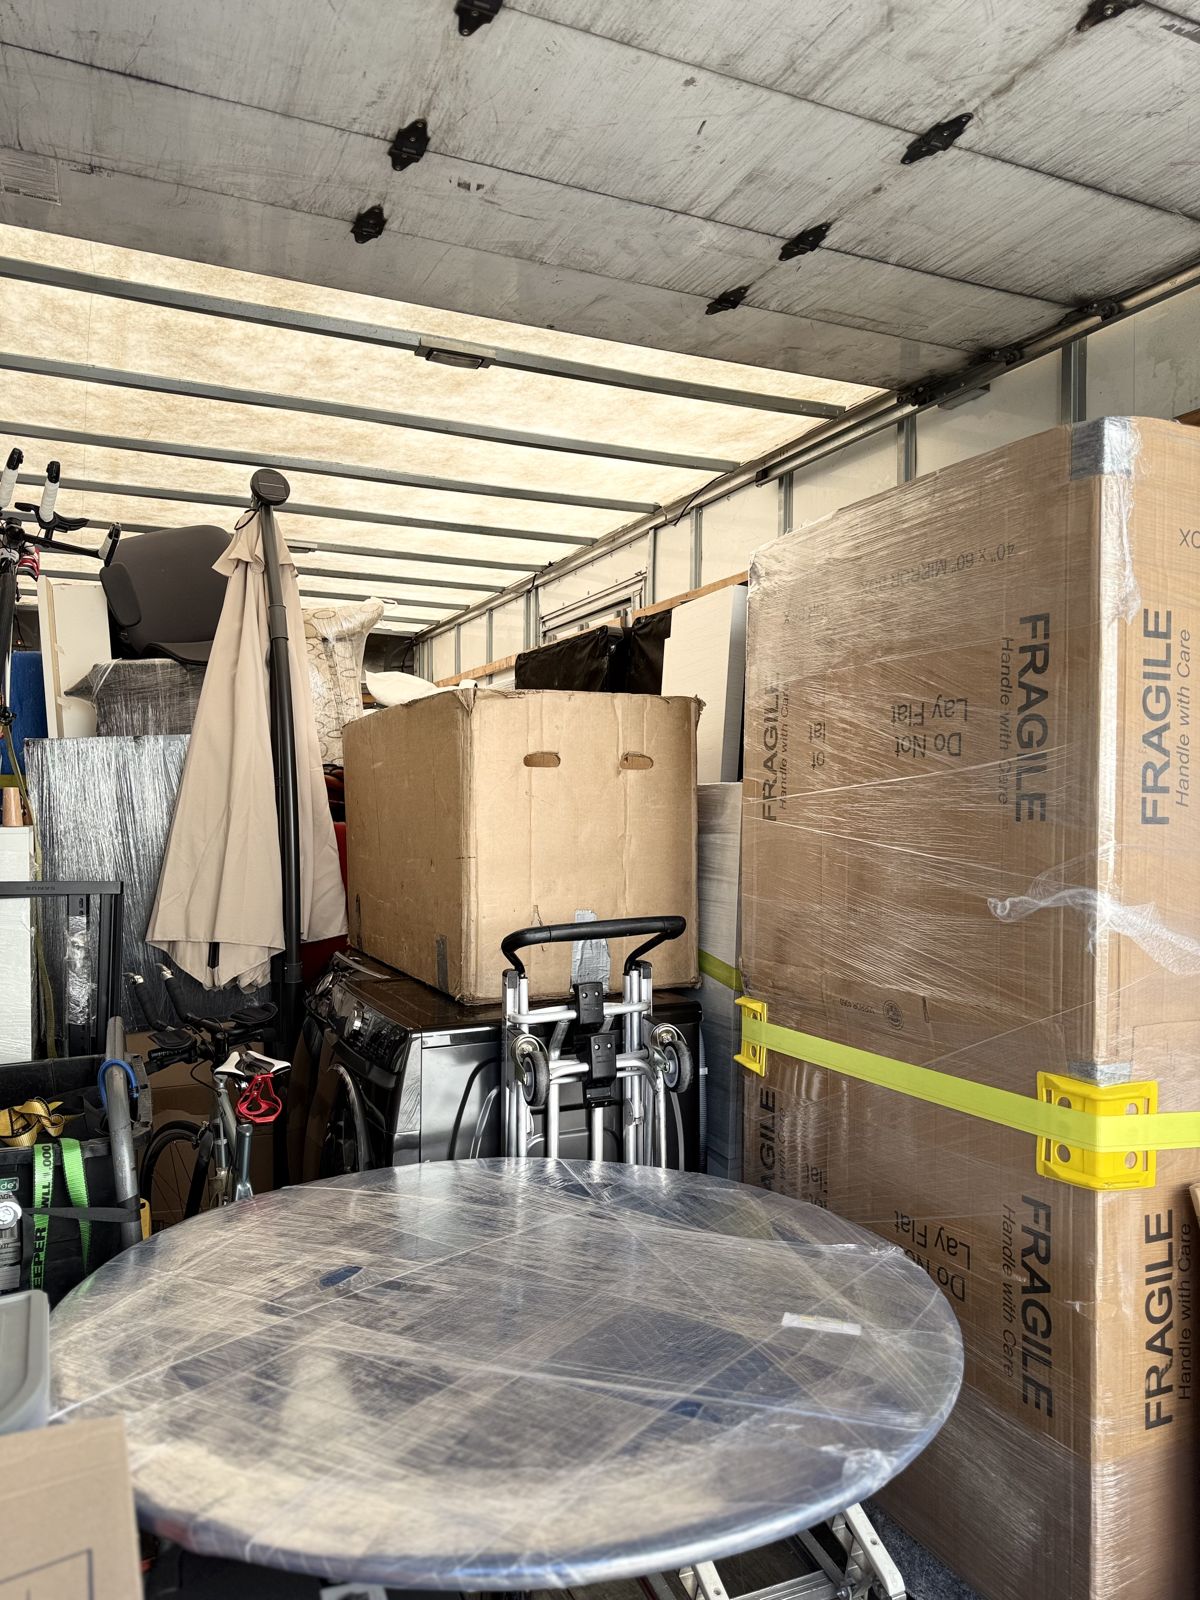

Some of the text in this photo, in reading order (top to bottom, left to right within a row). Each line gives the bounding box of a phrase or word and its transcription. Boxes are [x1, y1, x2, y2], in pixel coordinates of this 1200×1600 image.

[1000, 636, 1015, 706] Handle
[781, 723, 789, 751] with
[890, 694, 969, 727] Lay Flat
[1000, 711, 1013, 750] with
[1015, 612, 1050, 823] FRAGILE
[1141, 608, 1172, 825] FRAGILE
[1176, 629, 1191, 808] Handle with Care
[894, 732, 962, 758] Do Not
[779, 758, 788, 810] Handle
[760, 1088, 776, 1190] AGILE
[41, 1181, 51, 1208] WLL
[32, 1226, 47, 1289] EEPER
[894, 1210, 971, 1271] Lay Flat
[937, 1266, 966, 1303] Do
[1002, 1203, 1017, 1378] Handle with Care
[1021, 1194, 1054, 1418] FRAGILE
[1177, 1223, 1192, 1400] Handle with Care
[1144, 1209, 1173, 1430] FRAGILE
